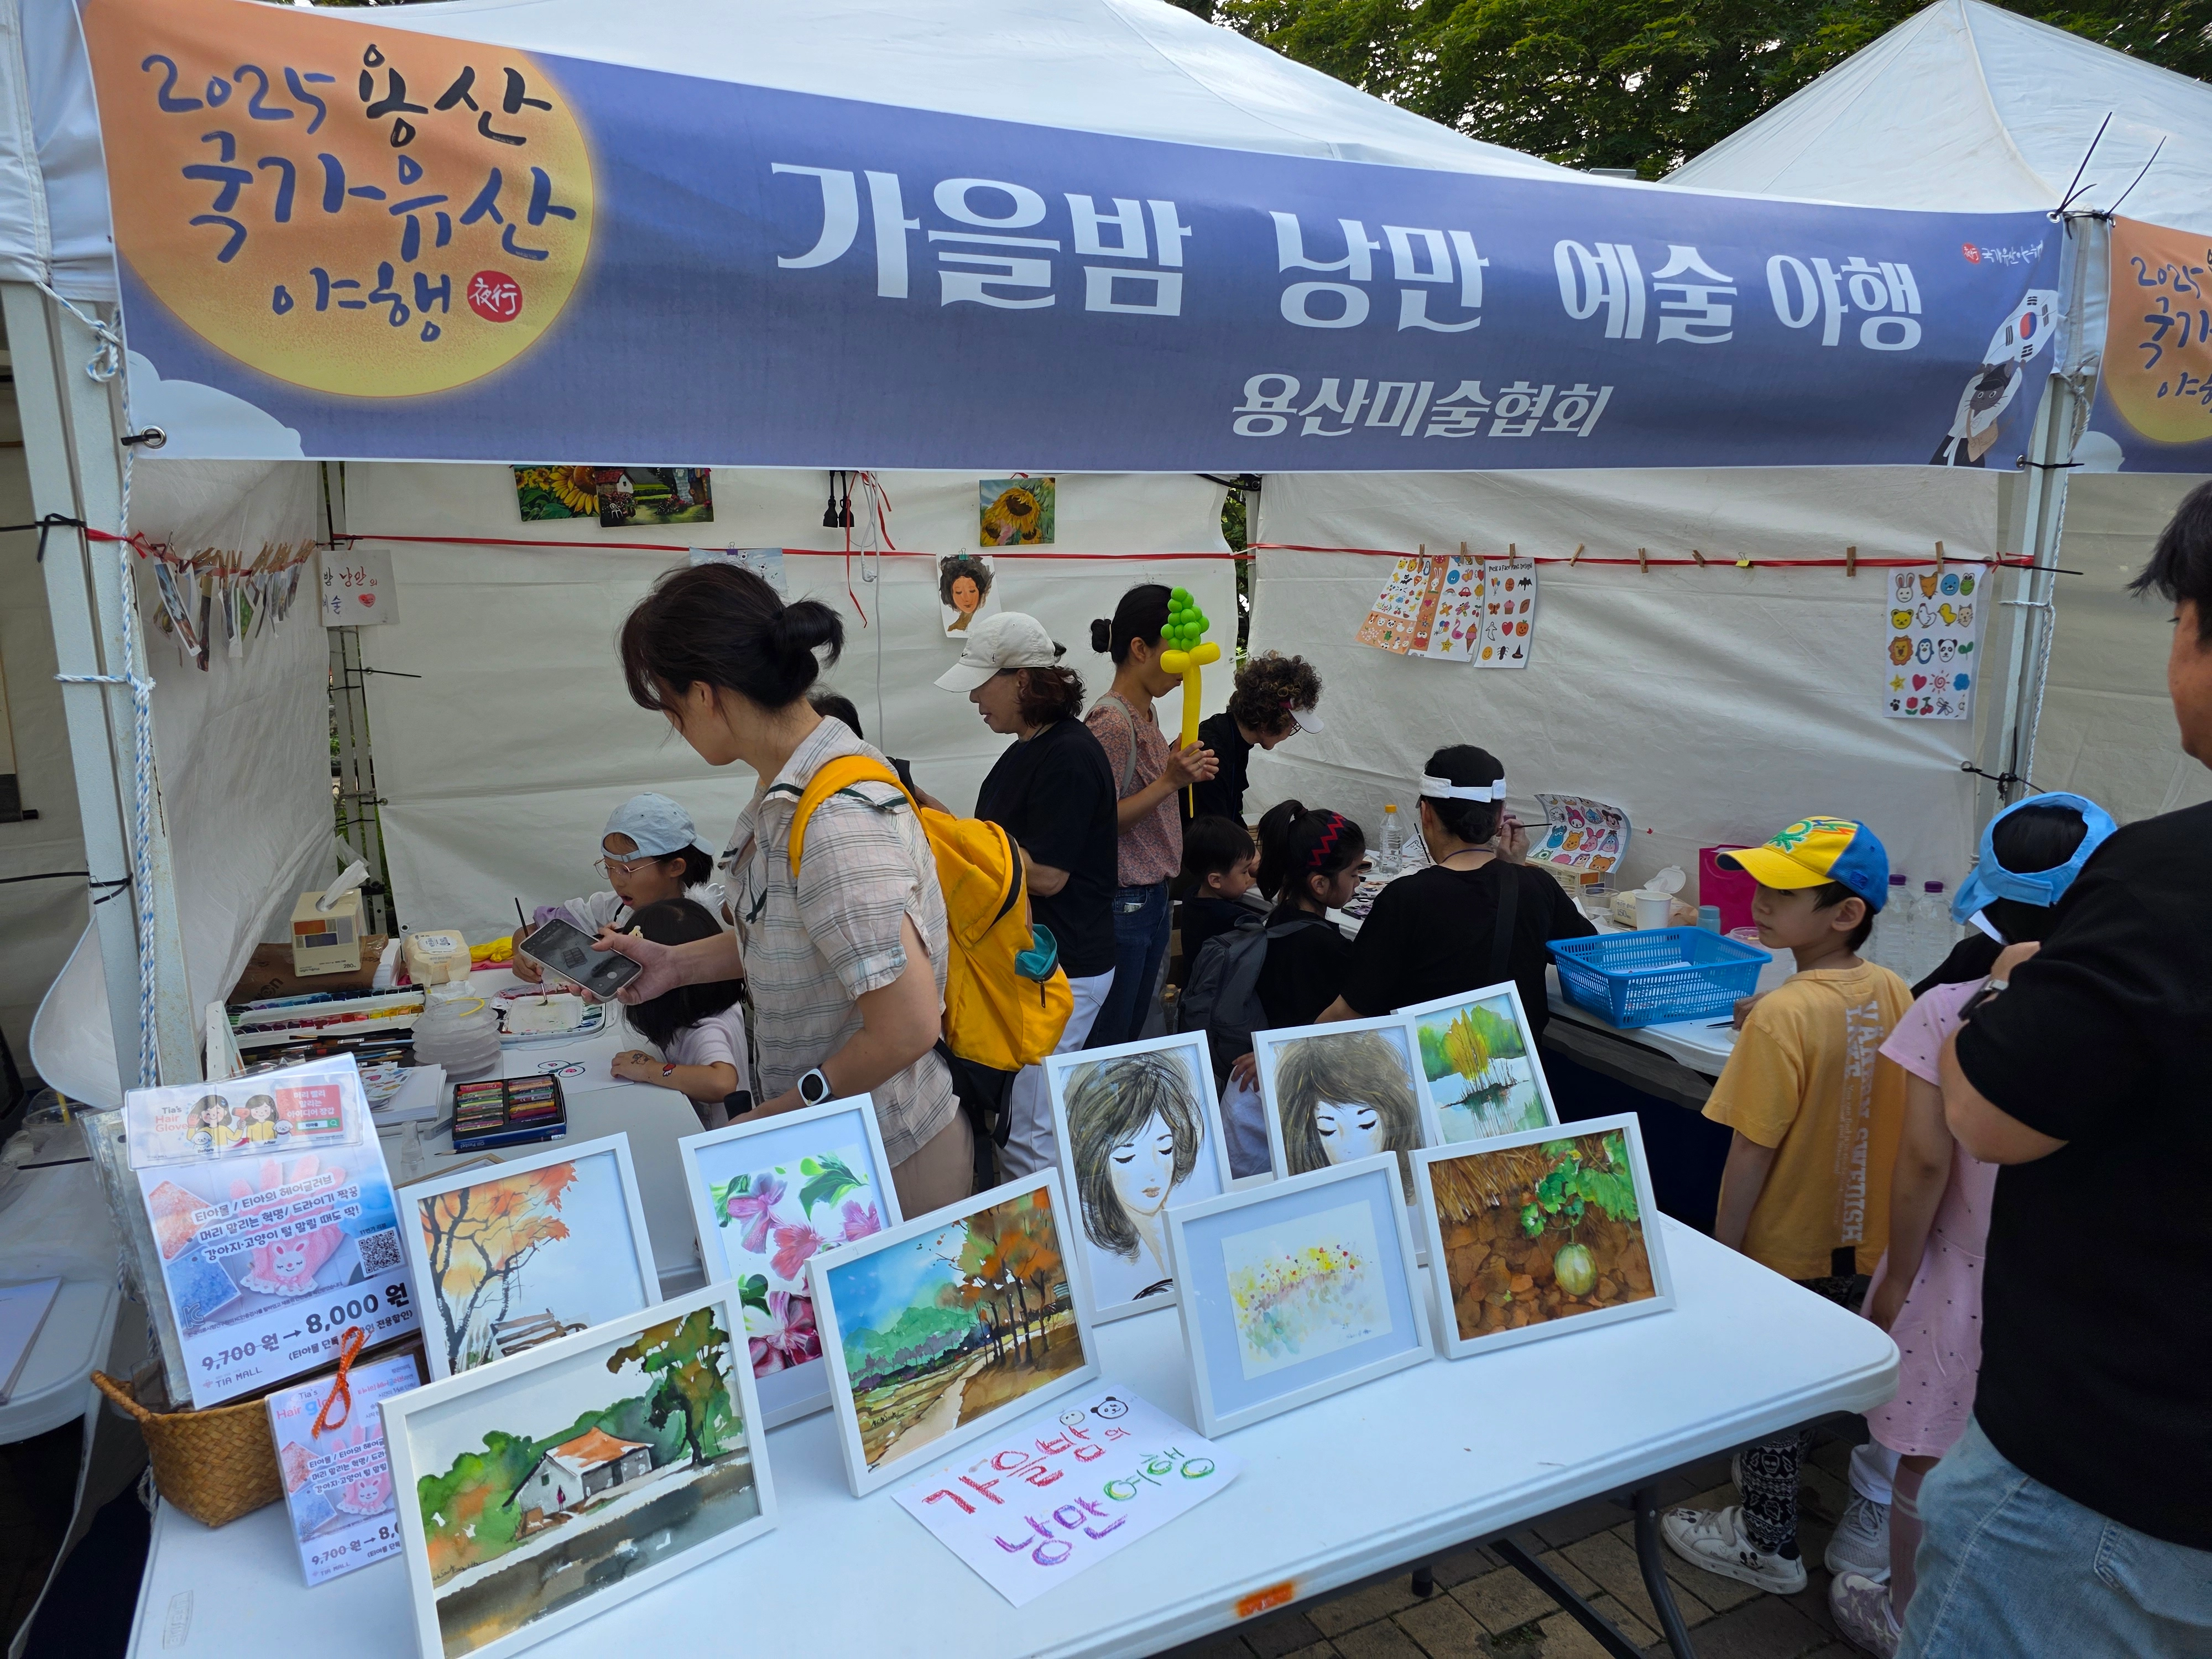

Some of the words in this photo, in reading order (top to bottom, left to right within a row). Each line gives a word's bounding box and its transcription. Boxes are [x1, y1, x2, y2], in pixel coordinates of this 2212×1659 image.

[142, 55, 336, 134] 2025
[359, 44, 552, 147] 용산
[182, 131, 577, 262] 국가유산
[771, 162, 1192, 316] 가을밤
[1269, 210, 1489, 333] 낭만
[1553, 239, 1738, 345] 예술
[1766, 254, 1922, 351] 야행
[2131, 256, 2204, 299] 2025
[272, 262, 451, 342] 야행
[469, 279, 518, 315] 夜行
[1233, 373, 1614, 439] 용산미술협회
[155, 1114, 180, 1124] Hair
[162, 1105, 182, 1114] Tia's
[155, 1123, 189, 1133] Glove
[195, 1204, 230, 1222] 티아몰
[242, 1191, 276, 1208] 티아의
[279, 1175, 332, 1196] 헤어글러브
[200, 1227, 223, 1241] 머리
[226, 1217, 259, 1235] 말리는
[293, 1193, 335, 1213] 드라이기
[337, 1186, 358, 1199] 짝꿍
[281, 1227, 293, 1237] 털
[295, 1218, 317, 1233] 말릴
[320, 1211, 342, 1224] 때도
[344, 1205, 360, 1217] 딱!
[306, 1293, 379, 1334] 8,000
[385, 1282, 409, 1308] 원
[201, 1342, 257, 1371] 9,700
[261, 1333, 280, 1352] 원
[216, 1376, 232, 1388] TIA
[236, 1367, 263, 1381] MALL
[298, 1389, 318, 1400] Tia's
[276, 1406, 301, 1420] Hair
[309, 1456, 331, 1468] 티아몰
[339, 1446, 362, 1459] 티아의
[312, 1470, 327, 1481] 머리
[328, 1464, 350, 1476] 말리는
[312, 1545, 347, 1565] 9,700
[349, 1540, 362, 1552] 원
[333, 1562, 351, 1572] MALL
